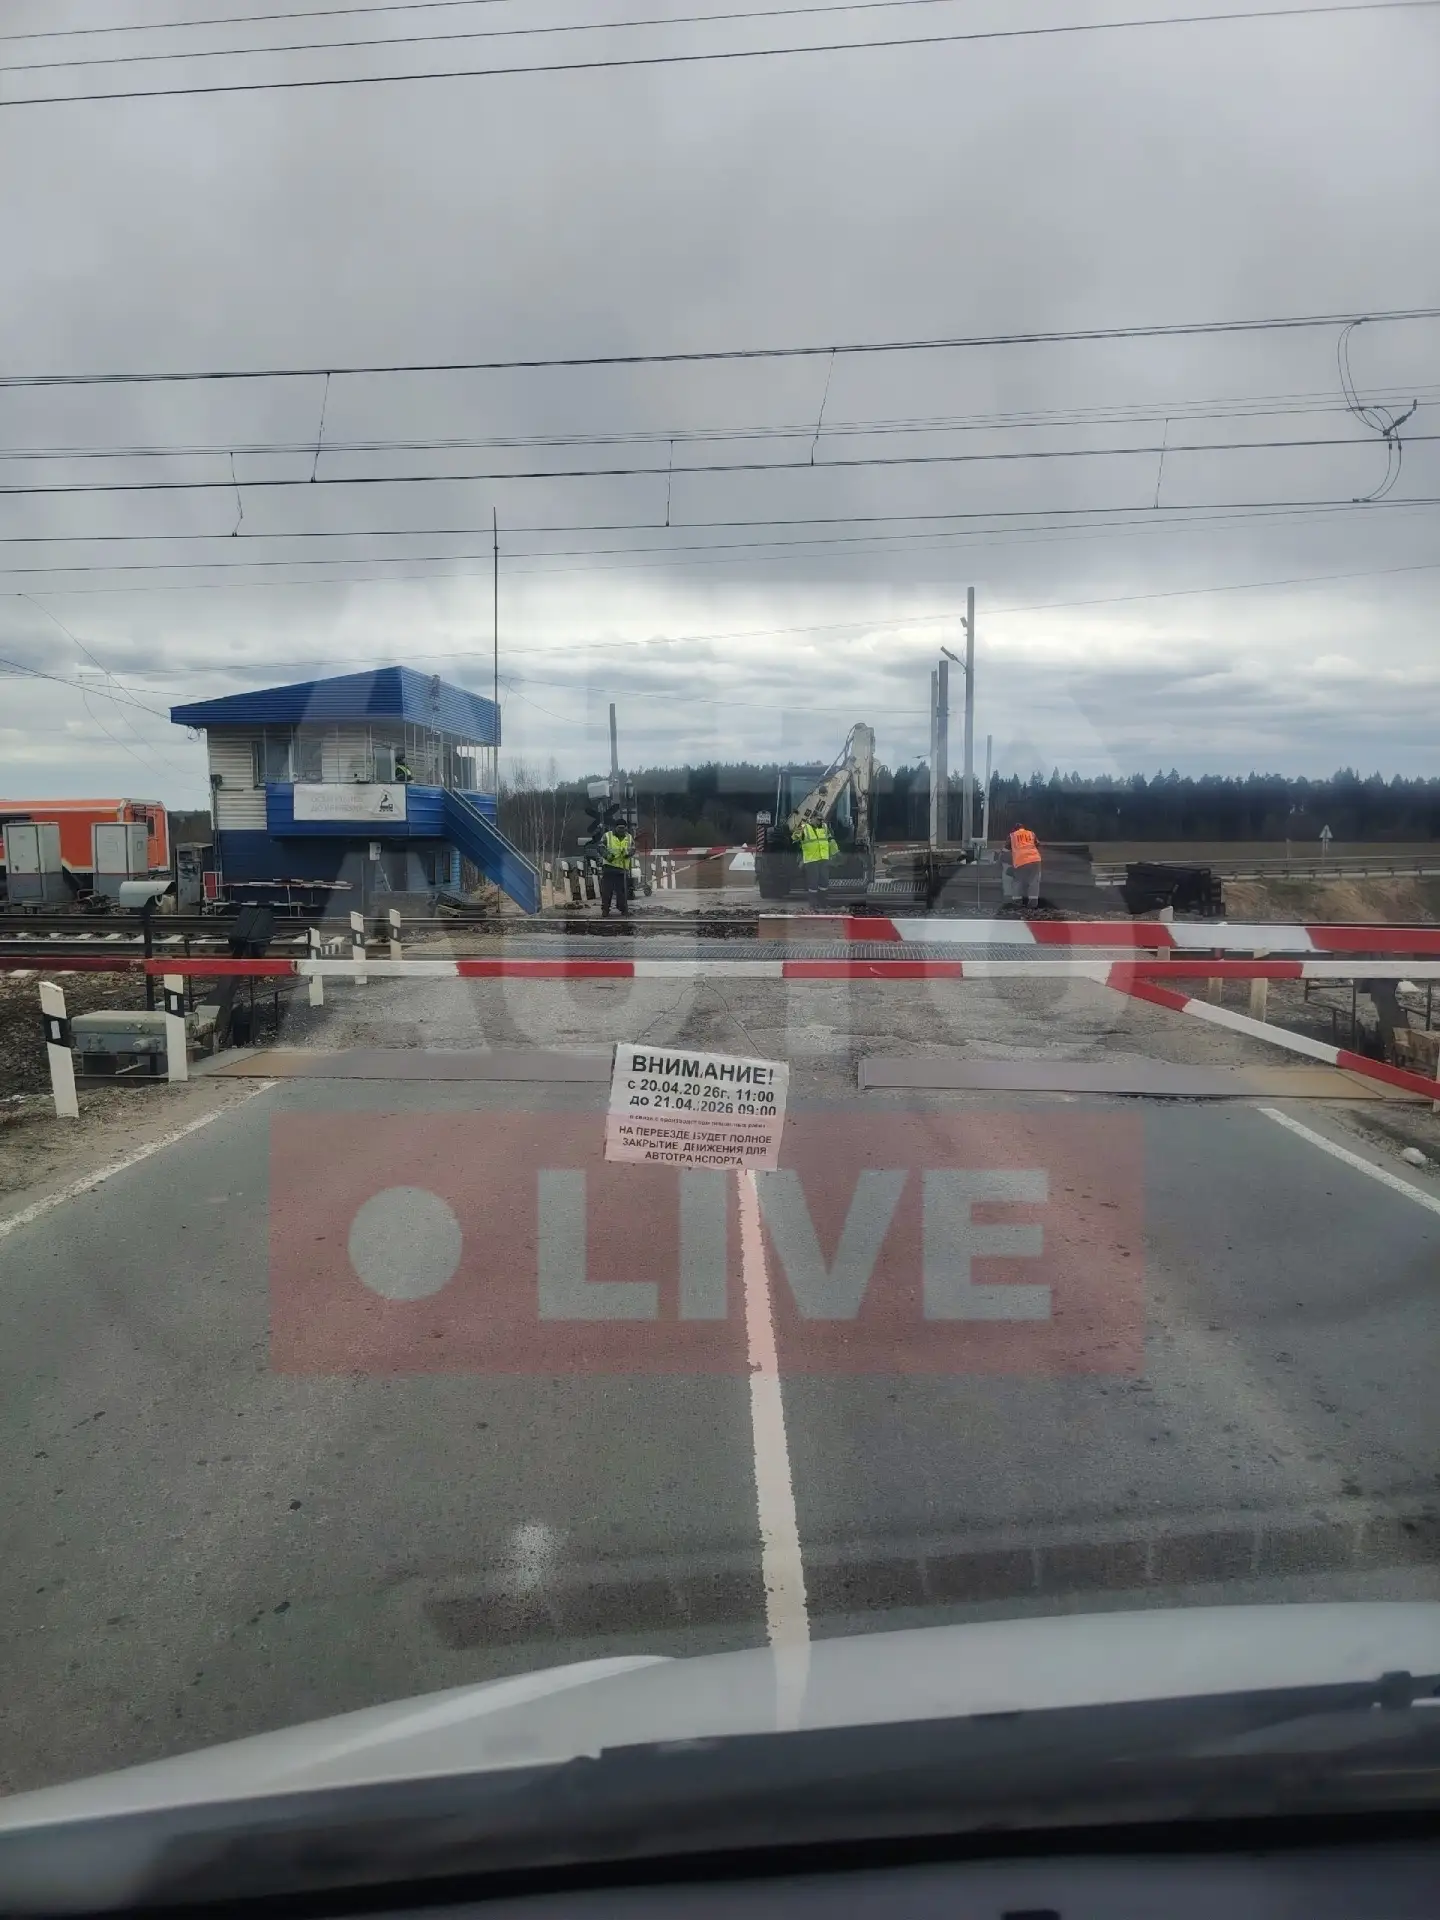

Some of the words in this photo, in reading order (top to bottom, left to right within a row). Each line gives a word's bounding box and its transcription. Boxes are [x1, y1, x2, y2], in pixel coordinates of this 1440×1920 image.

[632, 1055, 773, 1085] ВНИМАНИЕ!
[627, 1080, 636, 1089] с
[736, 1089, 774, 1103] 11:00
[629, 1096, 649, 1106] до
[654, 1095, 733, 1114] 21.04.2026
[737, 1103, 777, 1116] 09:00
[619, 1126, 634, 1135] НА
[636, 1127, 691, 1140] ПЕРЕЕЗДЕ
[693, 1131, 727, 1142] БУДЕТ
[729, 1134, 772, 1144] ПОЛНОЕ
[622, 1138, 679, 1149] ЗАКРЫТИЕ
[683, 1142, 743, 1153] ДВИЖЕНИЯ
[745, 1146, 767, 1156] ДЛЯ
[645, 1151, 743, 1165] АВТОТРАНСПОРТА
